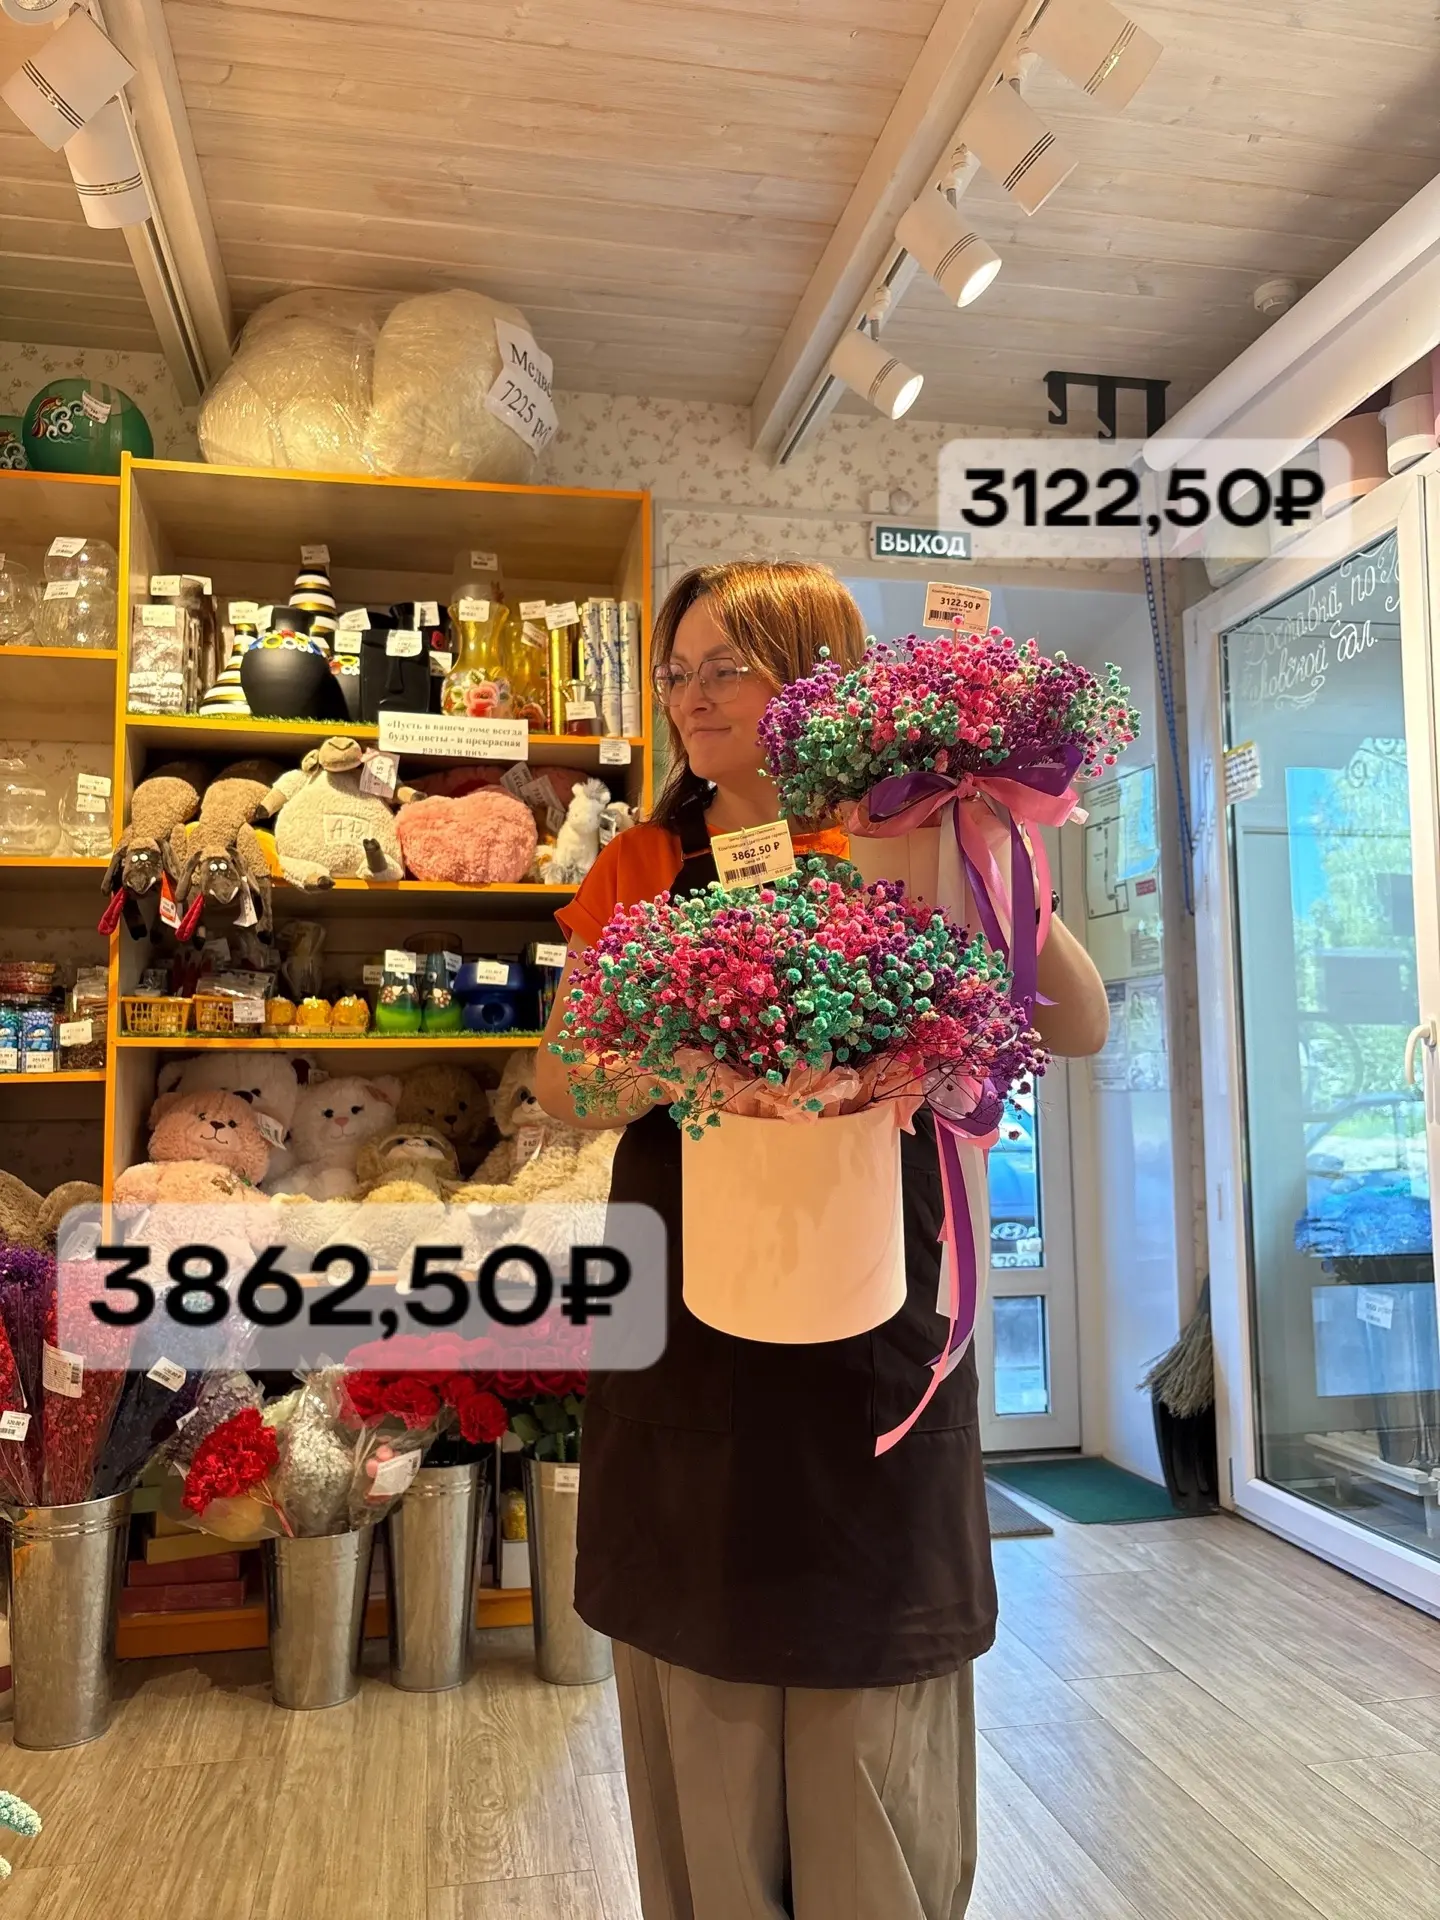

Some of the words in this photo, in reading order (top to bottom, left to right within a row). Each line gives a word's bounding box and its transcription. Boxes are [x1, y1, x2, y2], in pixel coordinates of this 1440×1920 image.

[500, 380, 537, 424] 7225
[531, 417, 552, 446] ру
[880, 531, 967, 557] ВЫХОД
[940, 596, 974, 610] 3122.50
[1243, 582, 1342, 667] Доставка
[1351, 565, 1376, 606] по
[388, 732, 415, 743] будут
[418, 735, 448, 744] цветы
[466, 737, 521, 748] прекрасная
[493, 727, 523, 736] всегда
[731, 843, 771, 862] 3862.50
